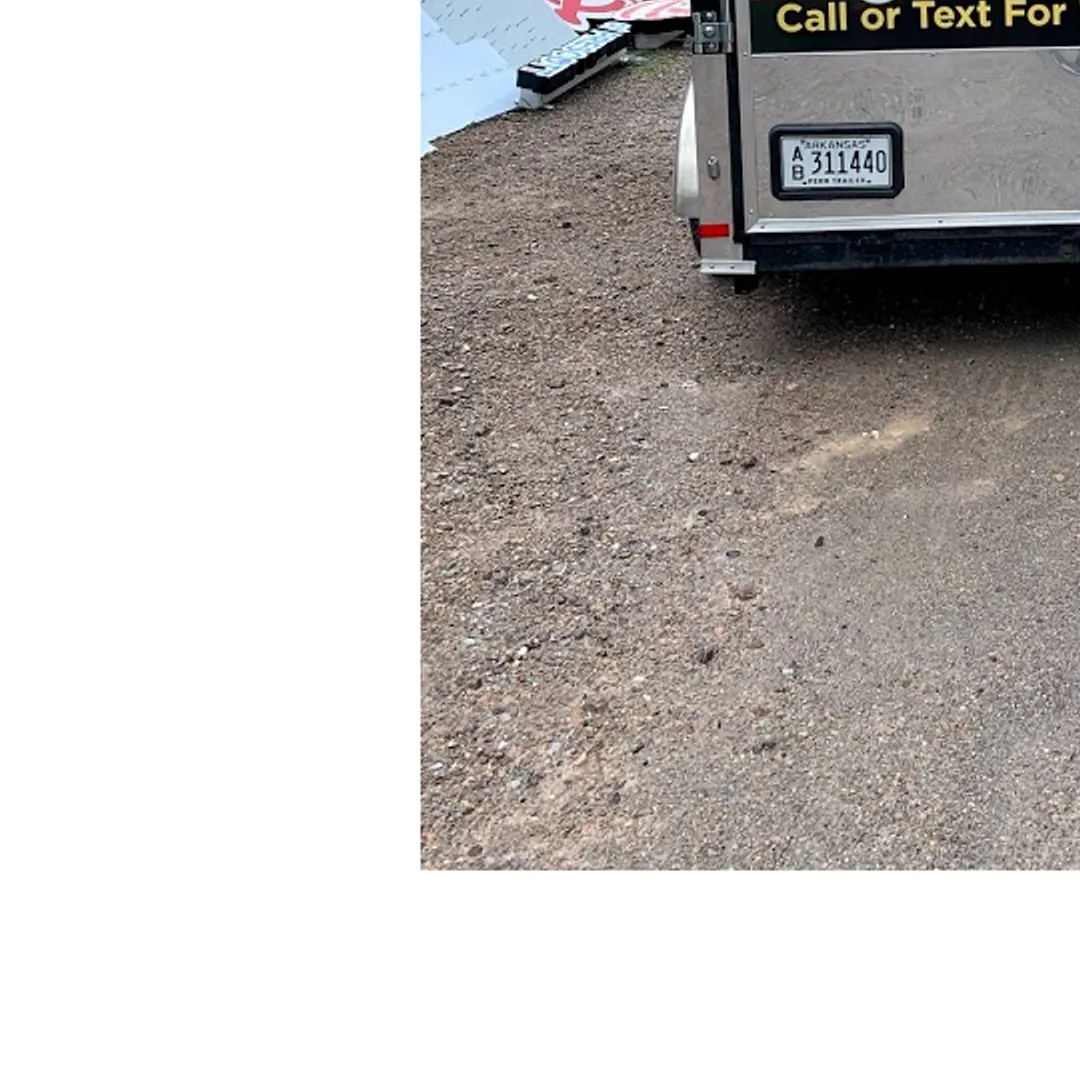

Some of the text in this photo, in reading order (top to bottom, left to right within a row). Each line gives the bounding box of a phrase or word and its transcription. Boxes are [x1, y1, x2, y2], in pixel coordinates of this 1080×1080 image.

[777, 1, 847, 32] Call
[861, 7, 901, 30] or
[912, 0, 991, 29] Text
[811, 149, 887, 175] 311440
